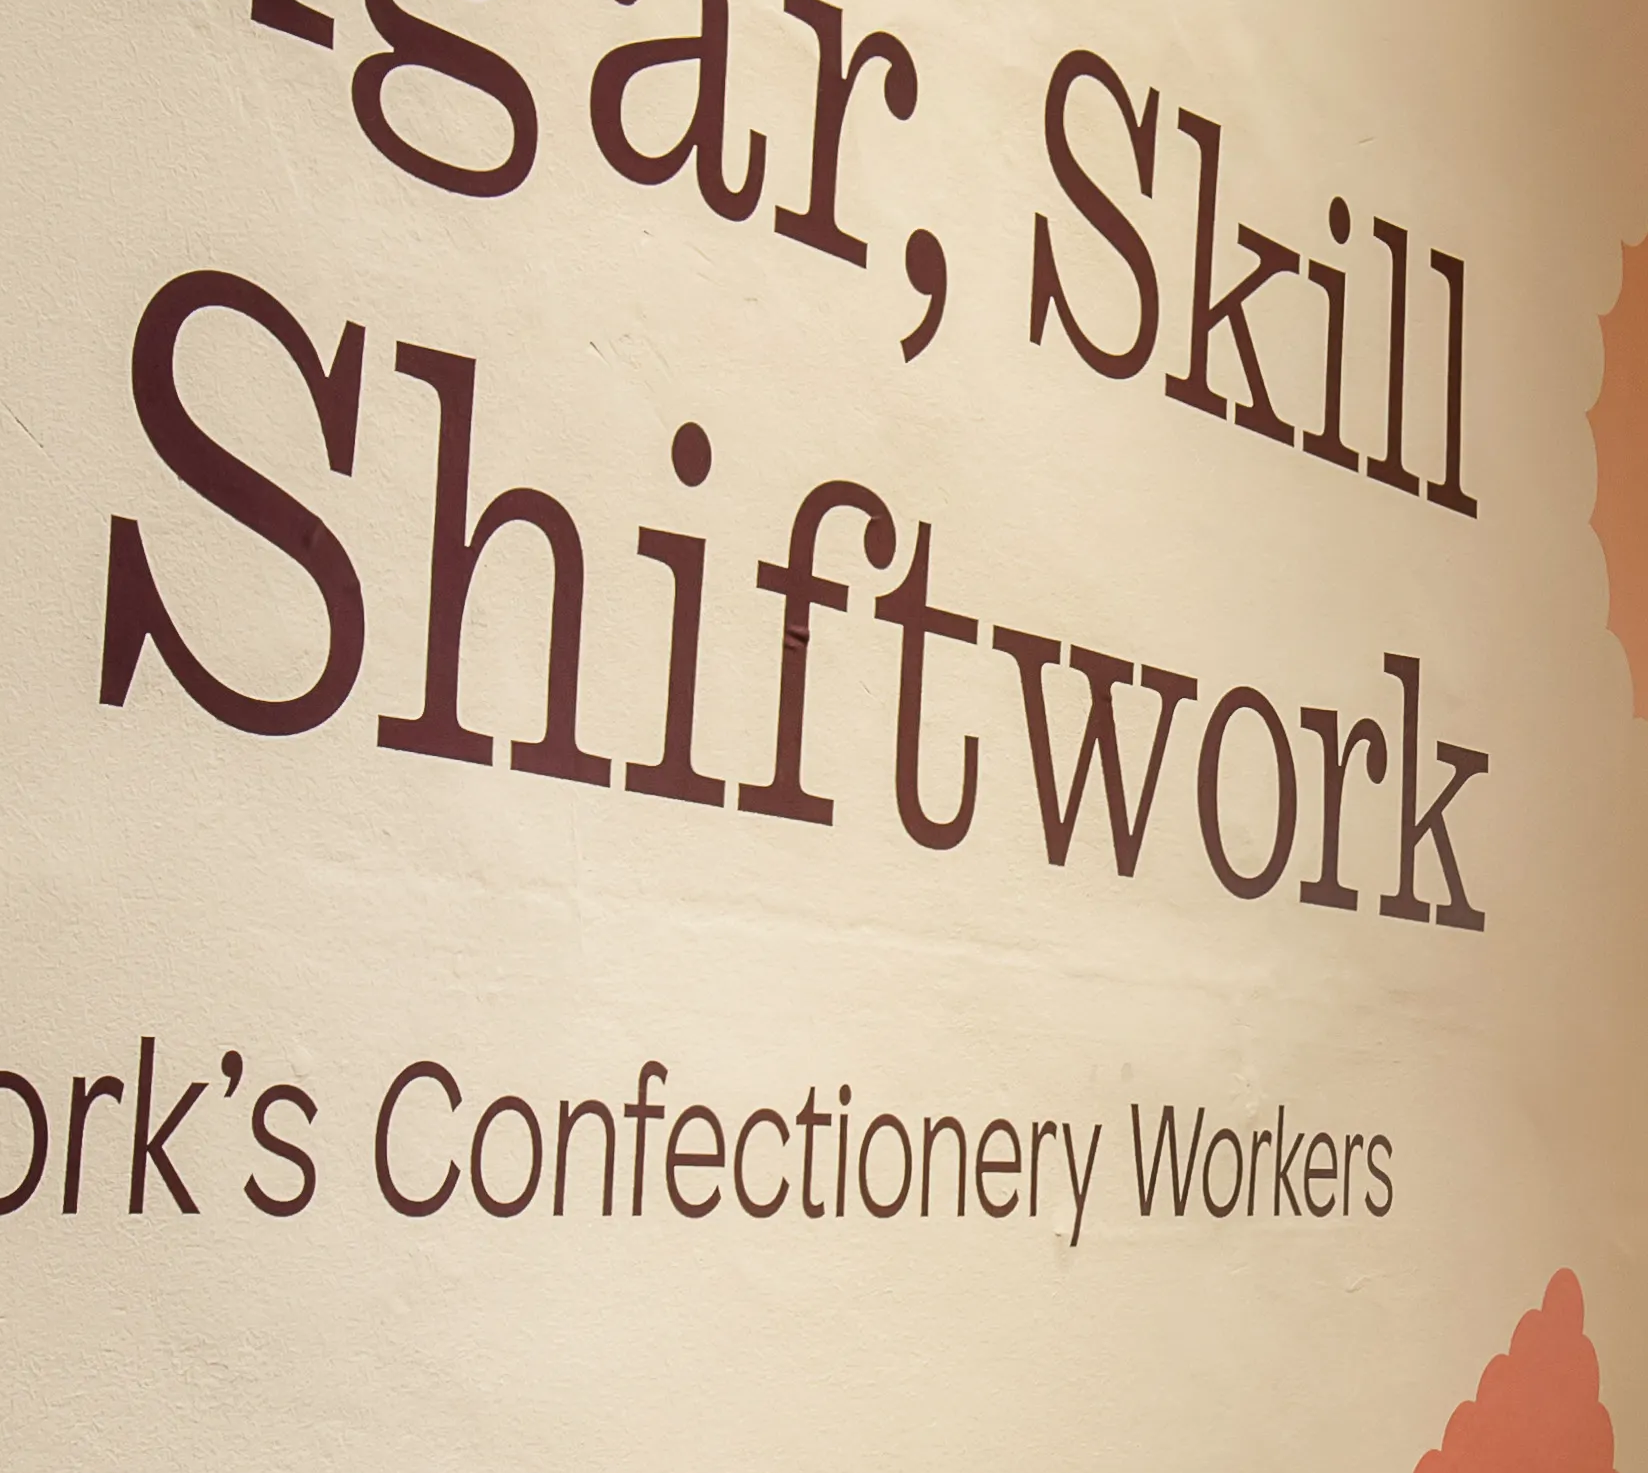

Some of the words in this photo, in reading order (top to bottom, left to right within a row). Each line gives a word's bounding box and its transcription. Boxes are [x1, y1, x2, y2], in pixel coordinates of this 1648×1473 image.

[1030, 50, 1477, 519] Skill
[102, 269, 1488, 933] Shiftwork
[375, 1061, 1102, 1247] Confectionery
[1131, 1104, 1392, 1218] Workers
